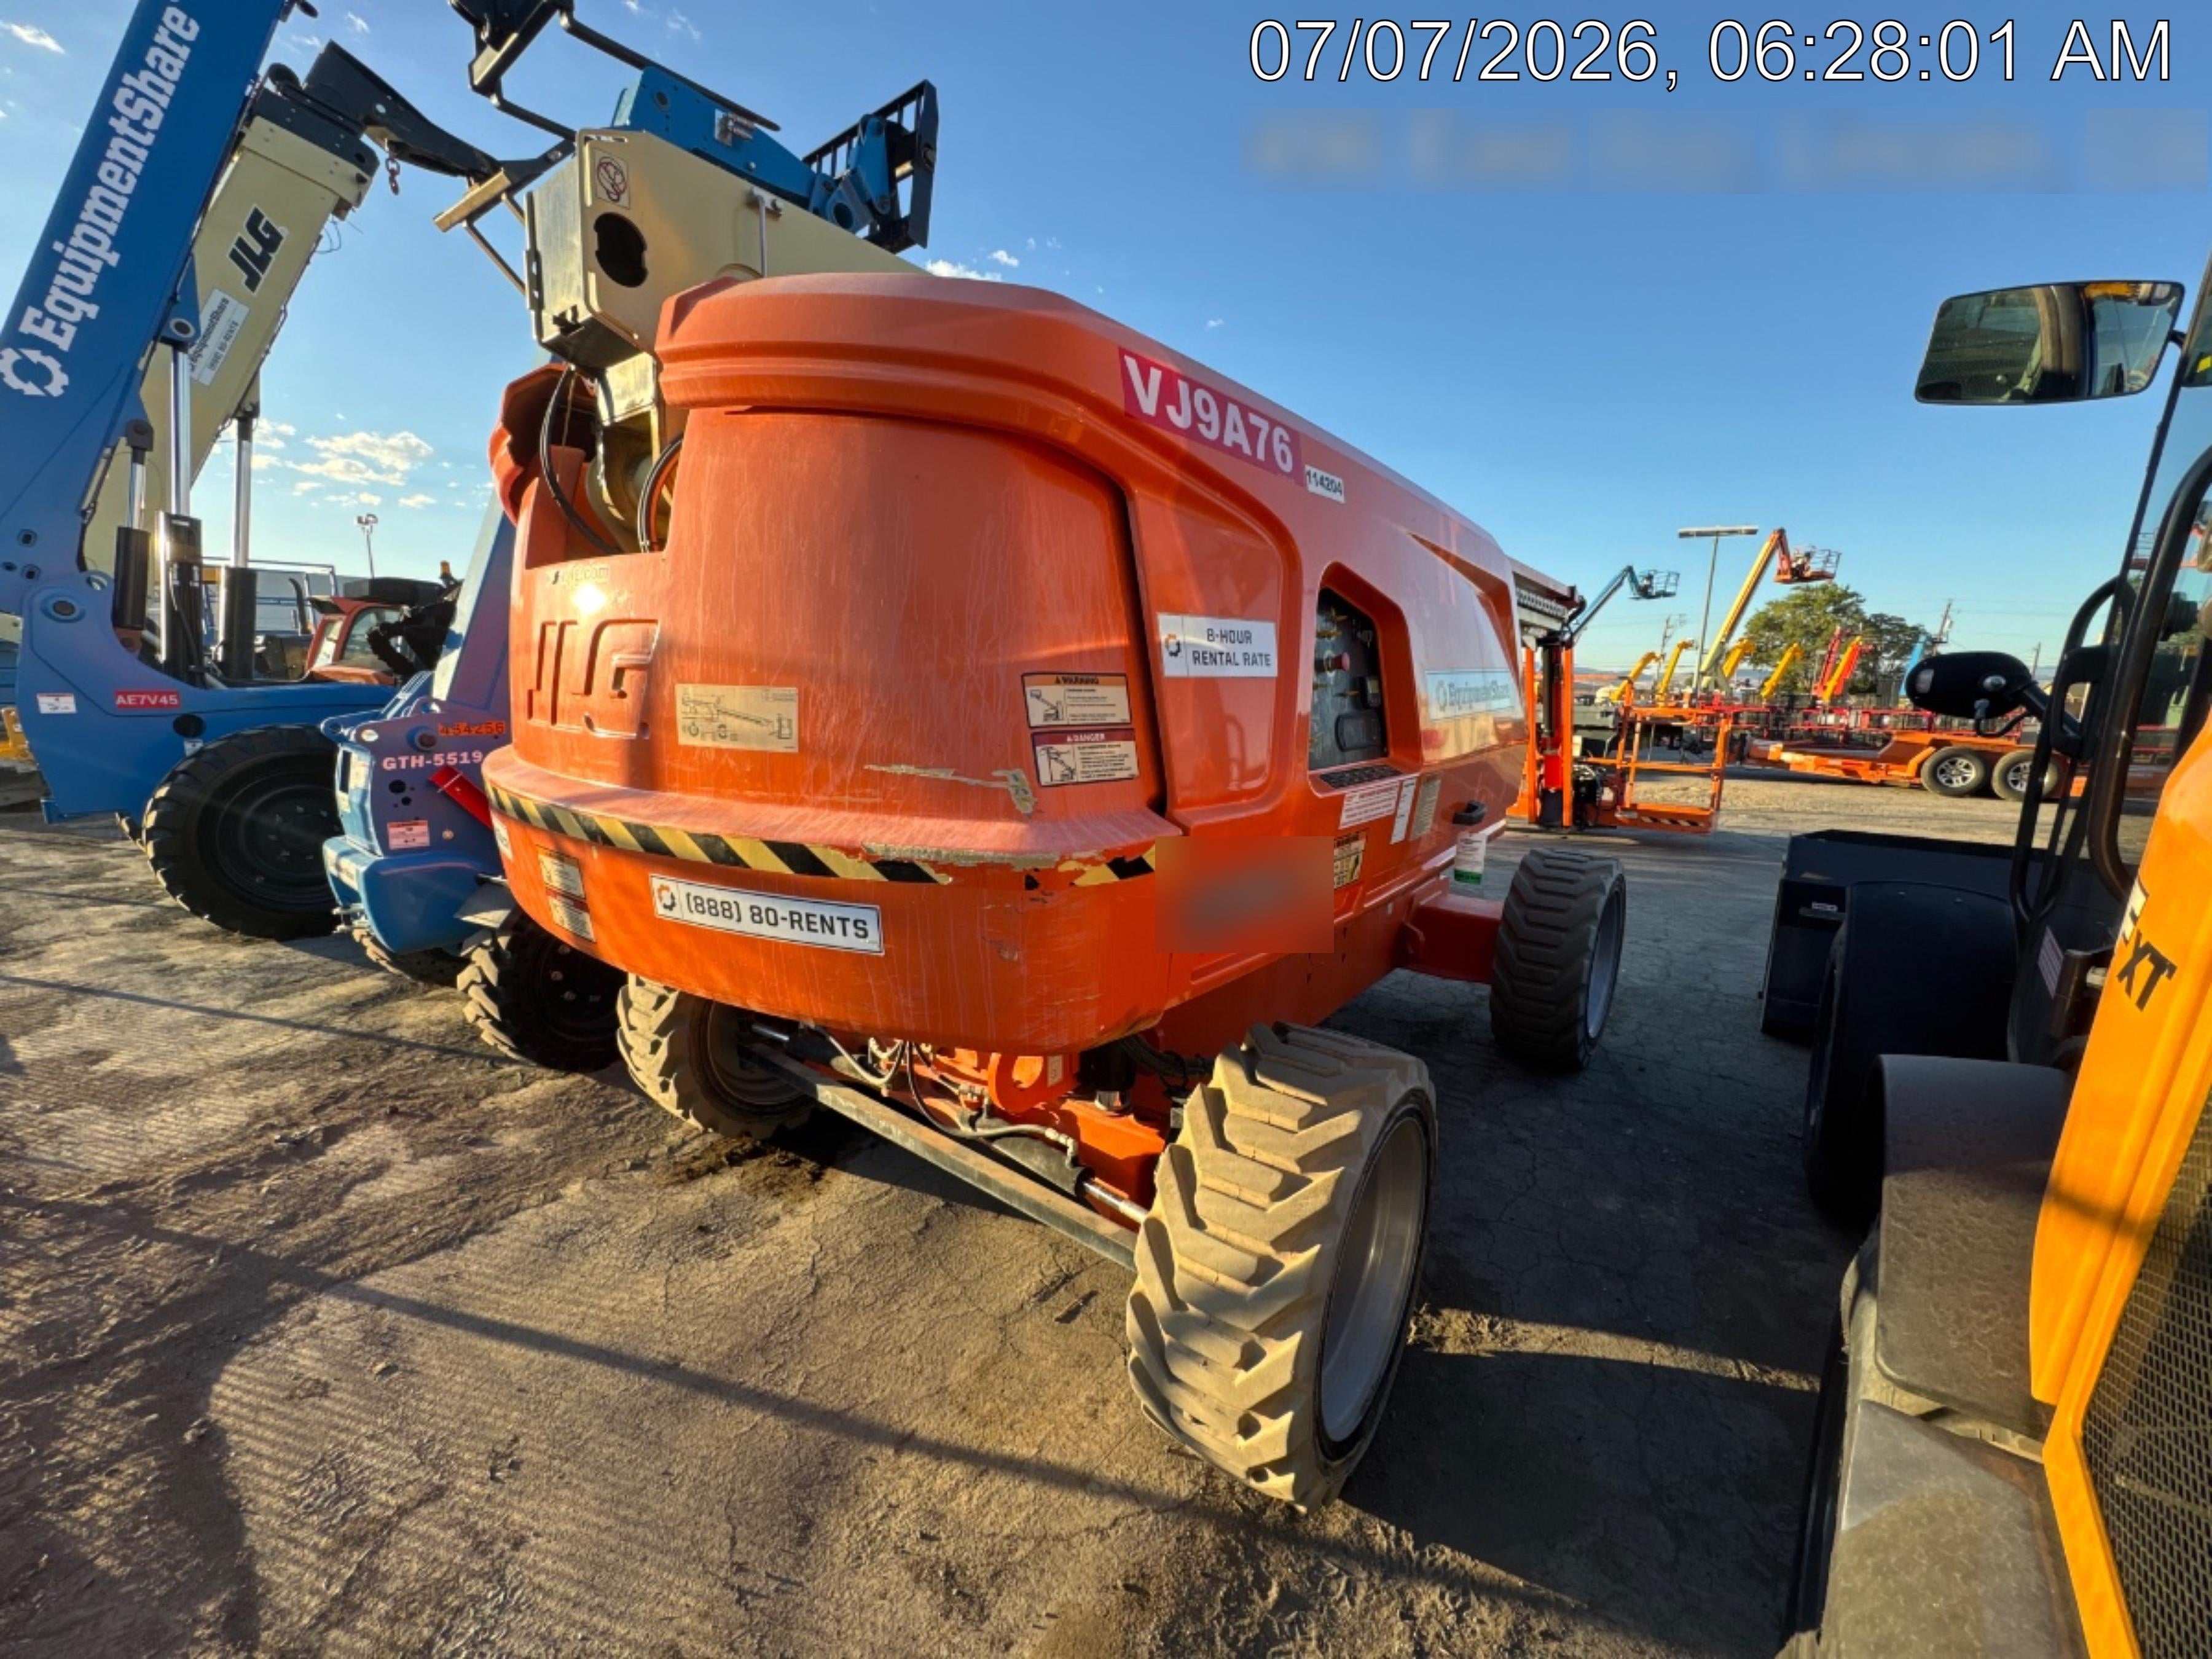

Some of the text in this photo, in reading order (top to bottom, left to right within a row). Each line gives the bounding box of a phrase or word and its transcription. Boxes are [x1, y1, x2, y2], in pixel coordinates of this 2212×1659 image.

[18, 6, 200, 352] EquipmentShare
[227, 205, 284, 294] JLG
[1123, 355, 1293, 473] VJ9A76
[1192, 650, 1271, 667] RENTAL RATE
[1206, 628, 1253, 645] 8-HOUR
[116, 694, 179, 705] AE7V45
[527, 618, 661, 739] JLG
[382, 750, 484, 771] GTH-5519
[685, 892, 869, 939] (888) 80-RENTS
